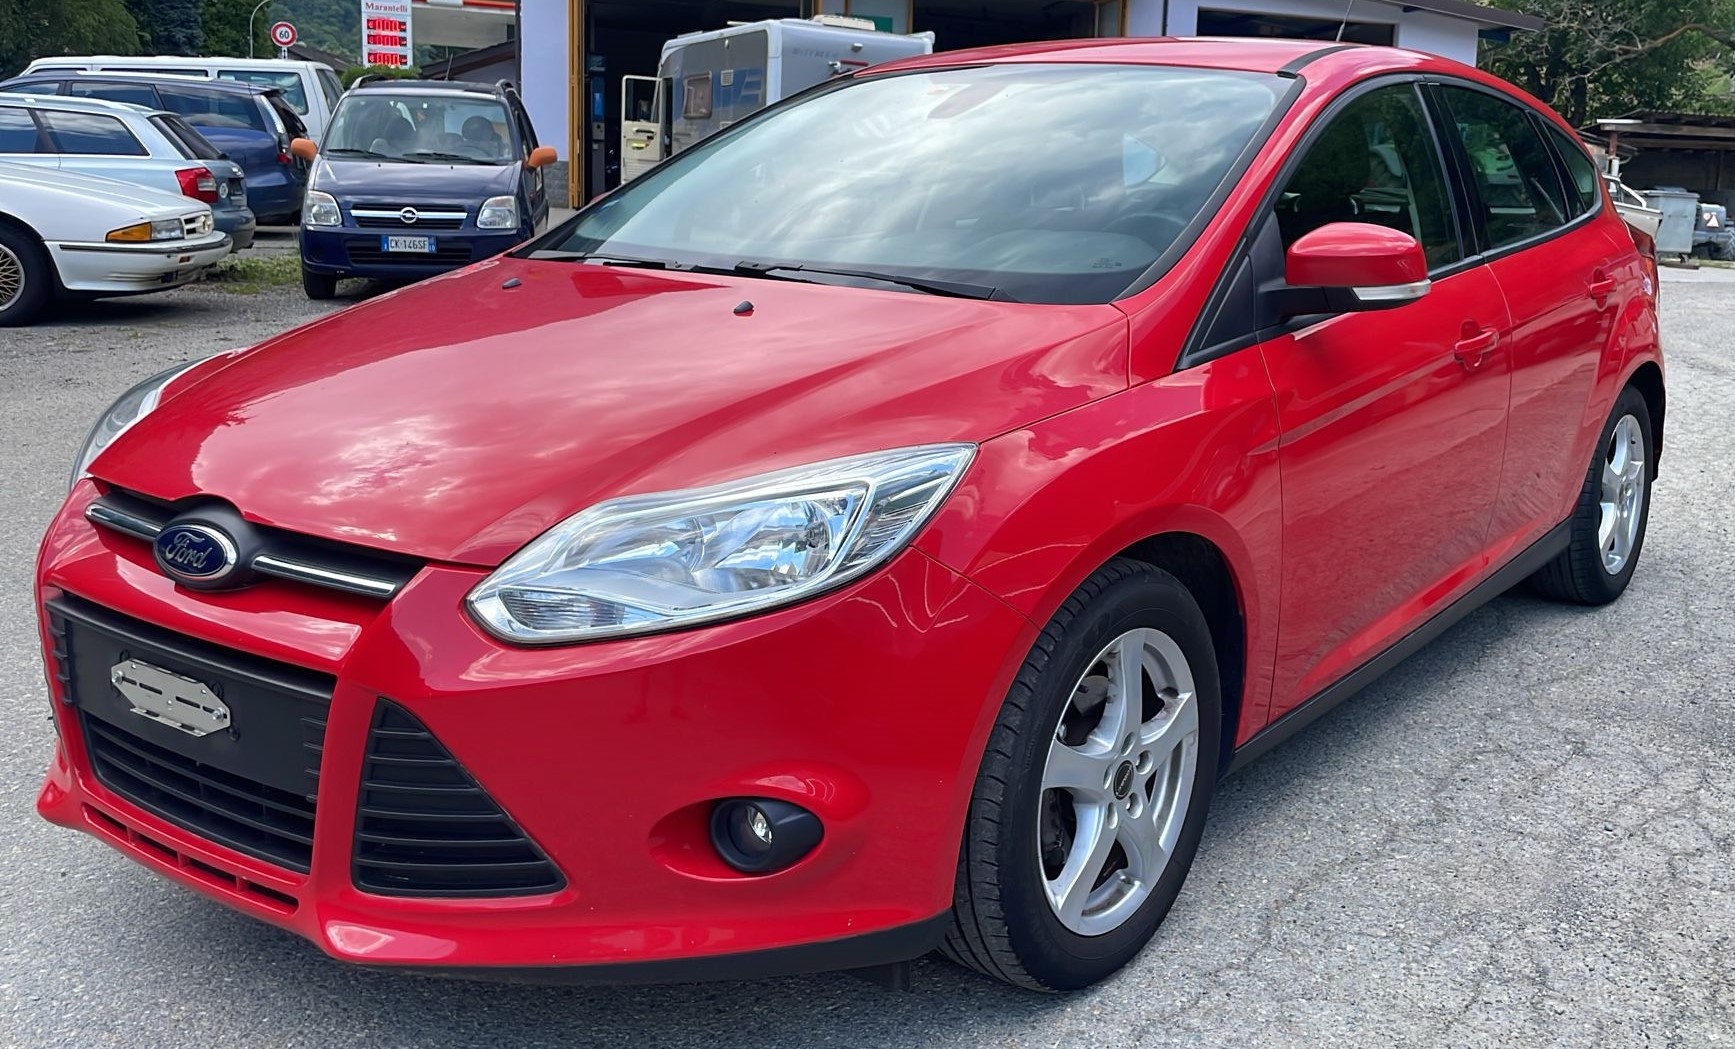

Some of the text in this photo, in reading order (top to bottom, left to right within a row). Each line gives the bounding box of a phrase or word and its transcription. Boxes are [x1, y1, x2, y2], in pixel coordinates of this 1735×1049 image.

[365, 2, 408, 13] Marantelli
[279, 30, 290, 40] 60
[161, 531, 213, 569] Ford
